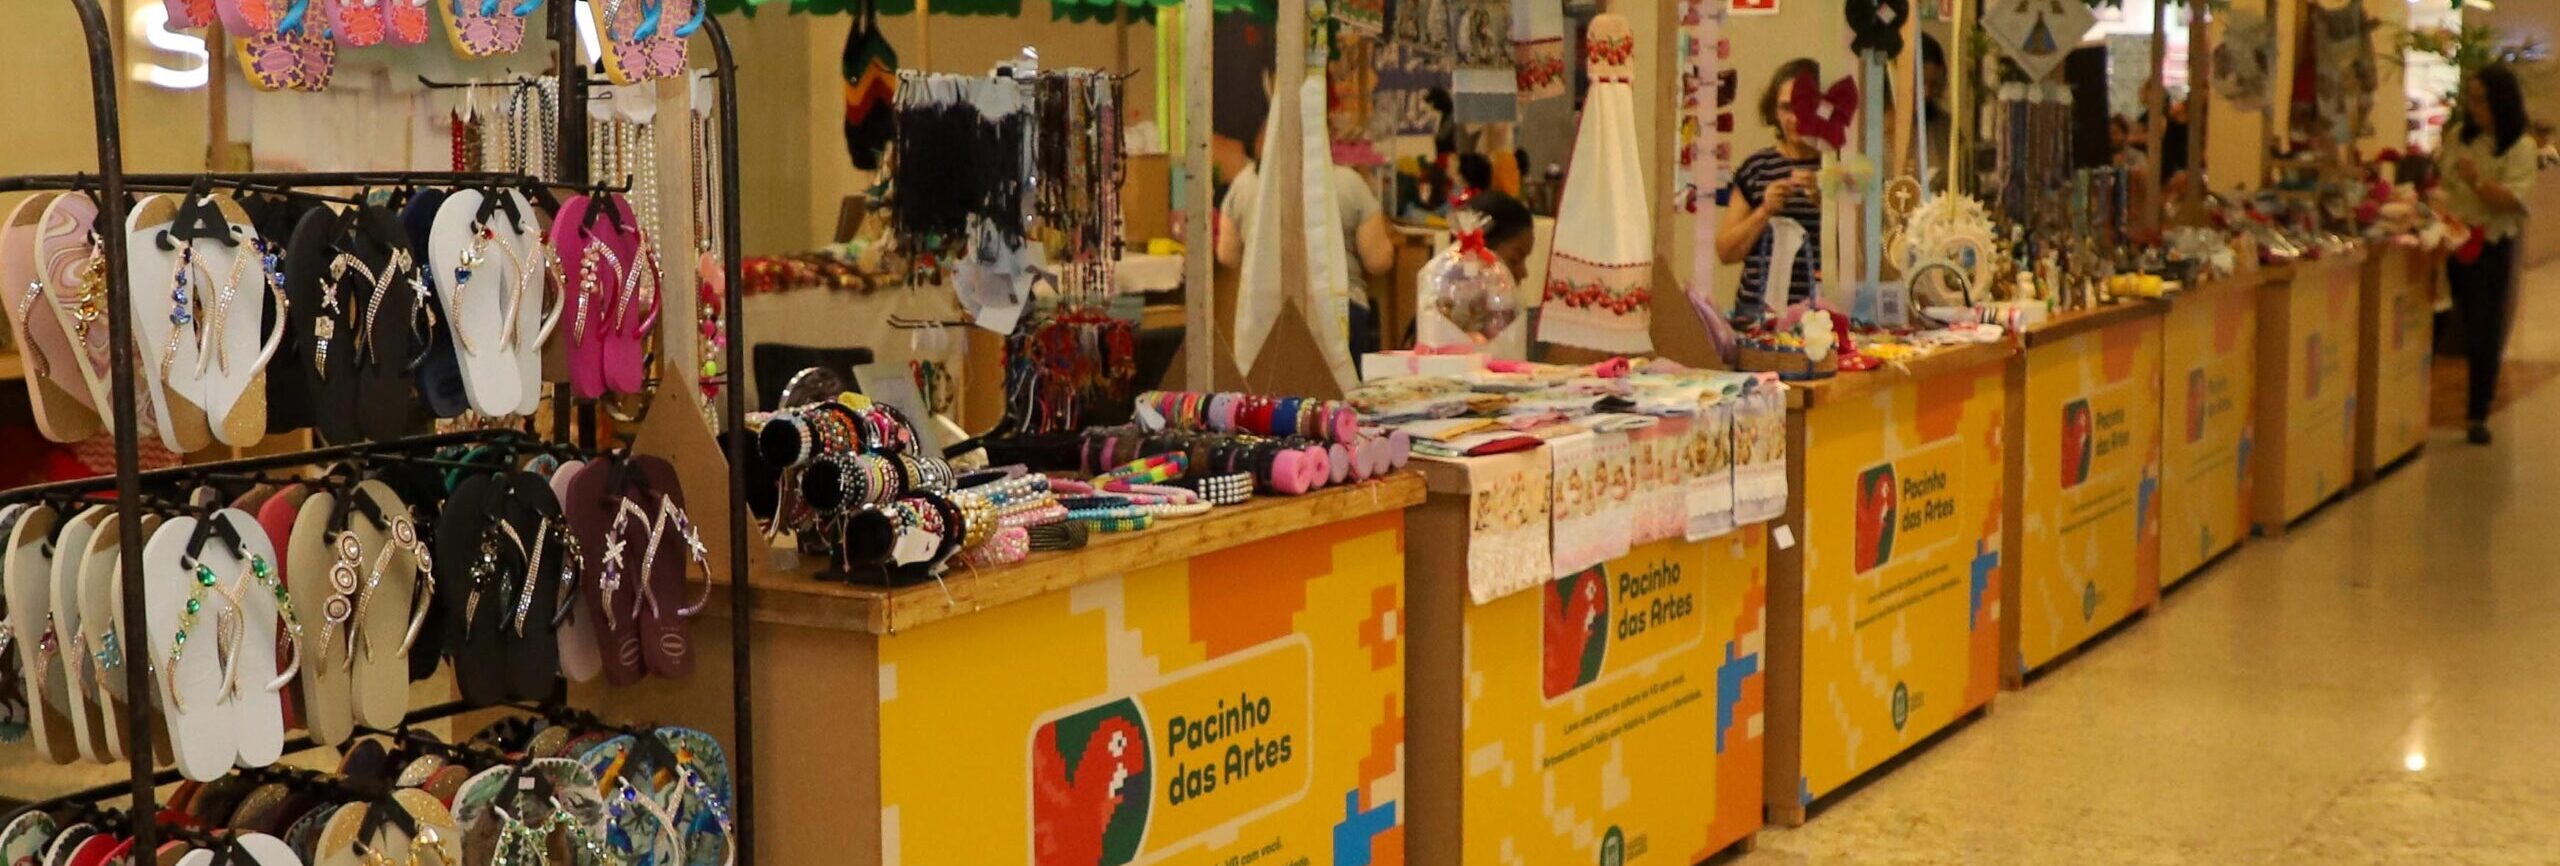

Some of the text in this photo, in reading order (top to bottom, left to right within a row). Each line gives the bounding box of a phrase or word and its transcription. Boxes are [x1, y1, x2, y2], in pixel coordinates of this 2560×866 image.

[1903, 468, 1947, 501] Pacinho
[1902, 498, 1955, 532] das Artes
[1618, 558, 1681, 603] Pacinho
[1618, 592, 1693, 640] das Artes
[1168, 692, 1272, 757] Pacinho
[1169, 733, 1292, 806] das Artes
[1241, 850, 1260, 866] com
